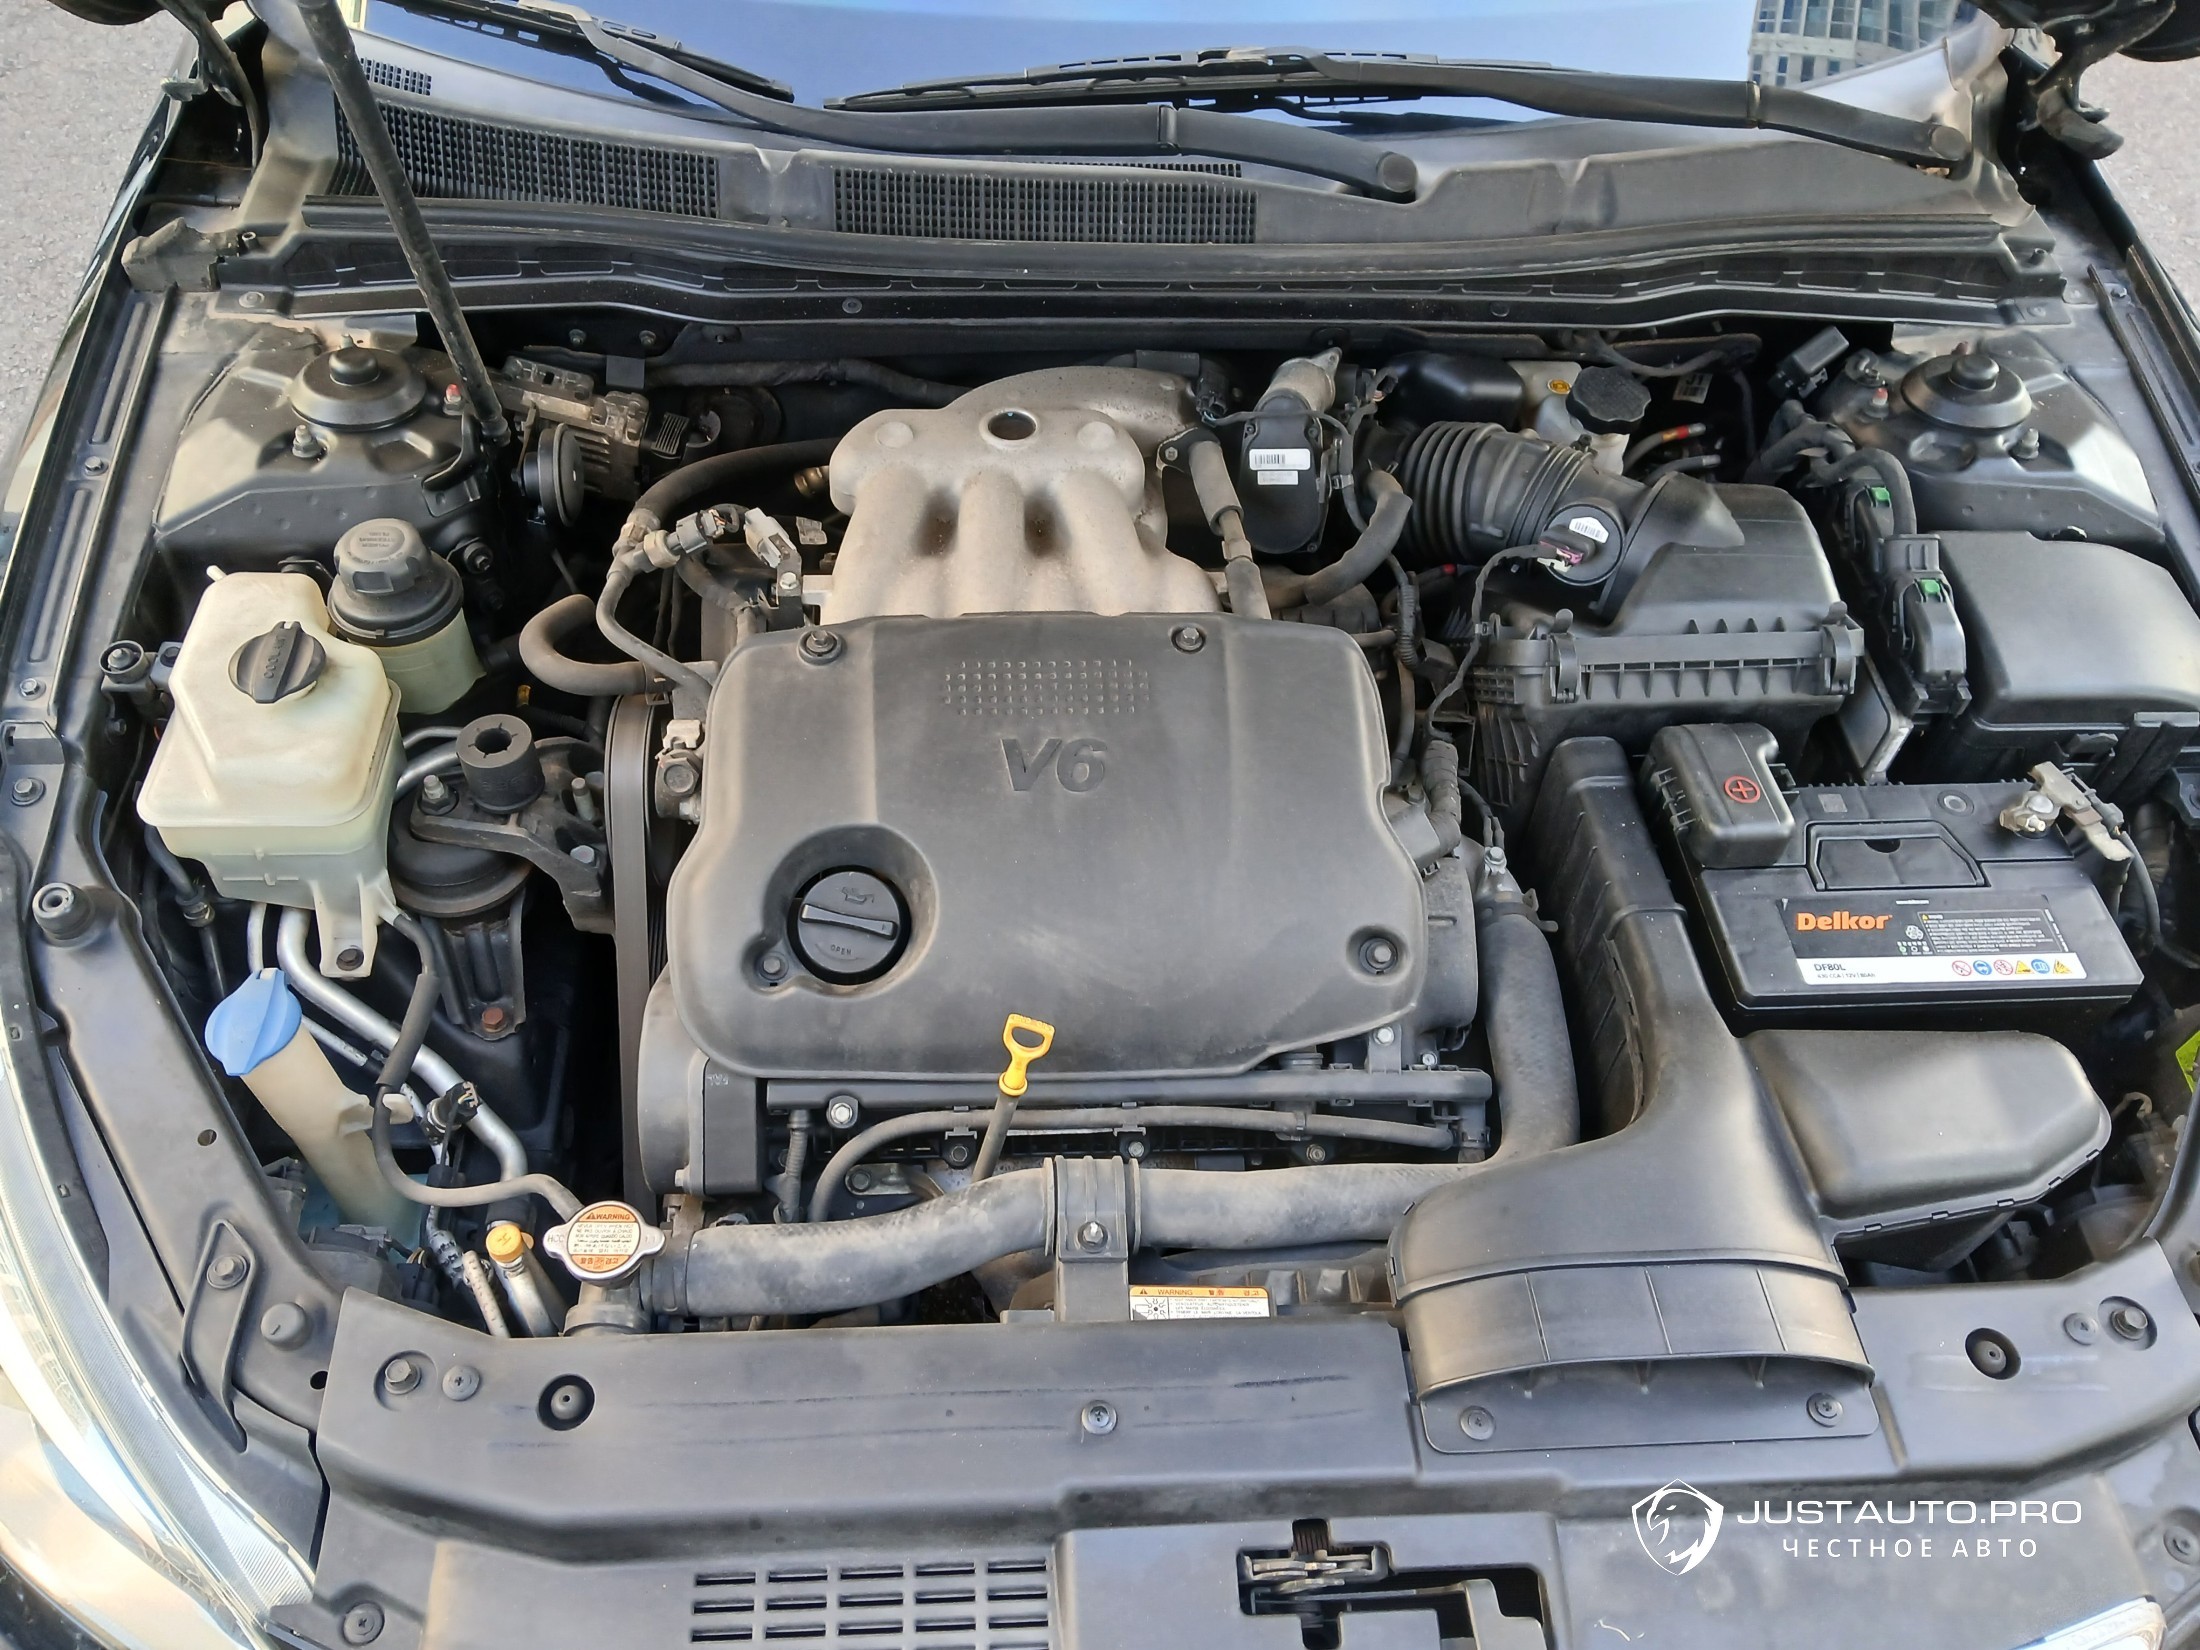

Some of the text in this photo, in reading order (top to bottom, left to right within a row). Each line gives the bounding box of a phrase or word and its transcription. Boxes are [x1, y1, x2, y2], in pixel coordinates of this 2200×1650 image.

[1000, 738, 1107, 792] V6
[1797, 911, 1889, 931] Delkor
[1814, 963, 1846, 971] DF80L
